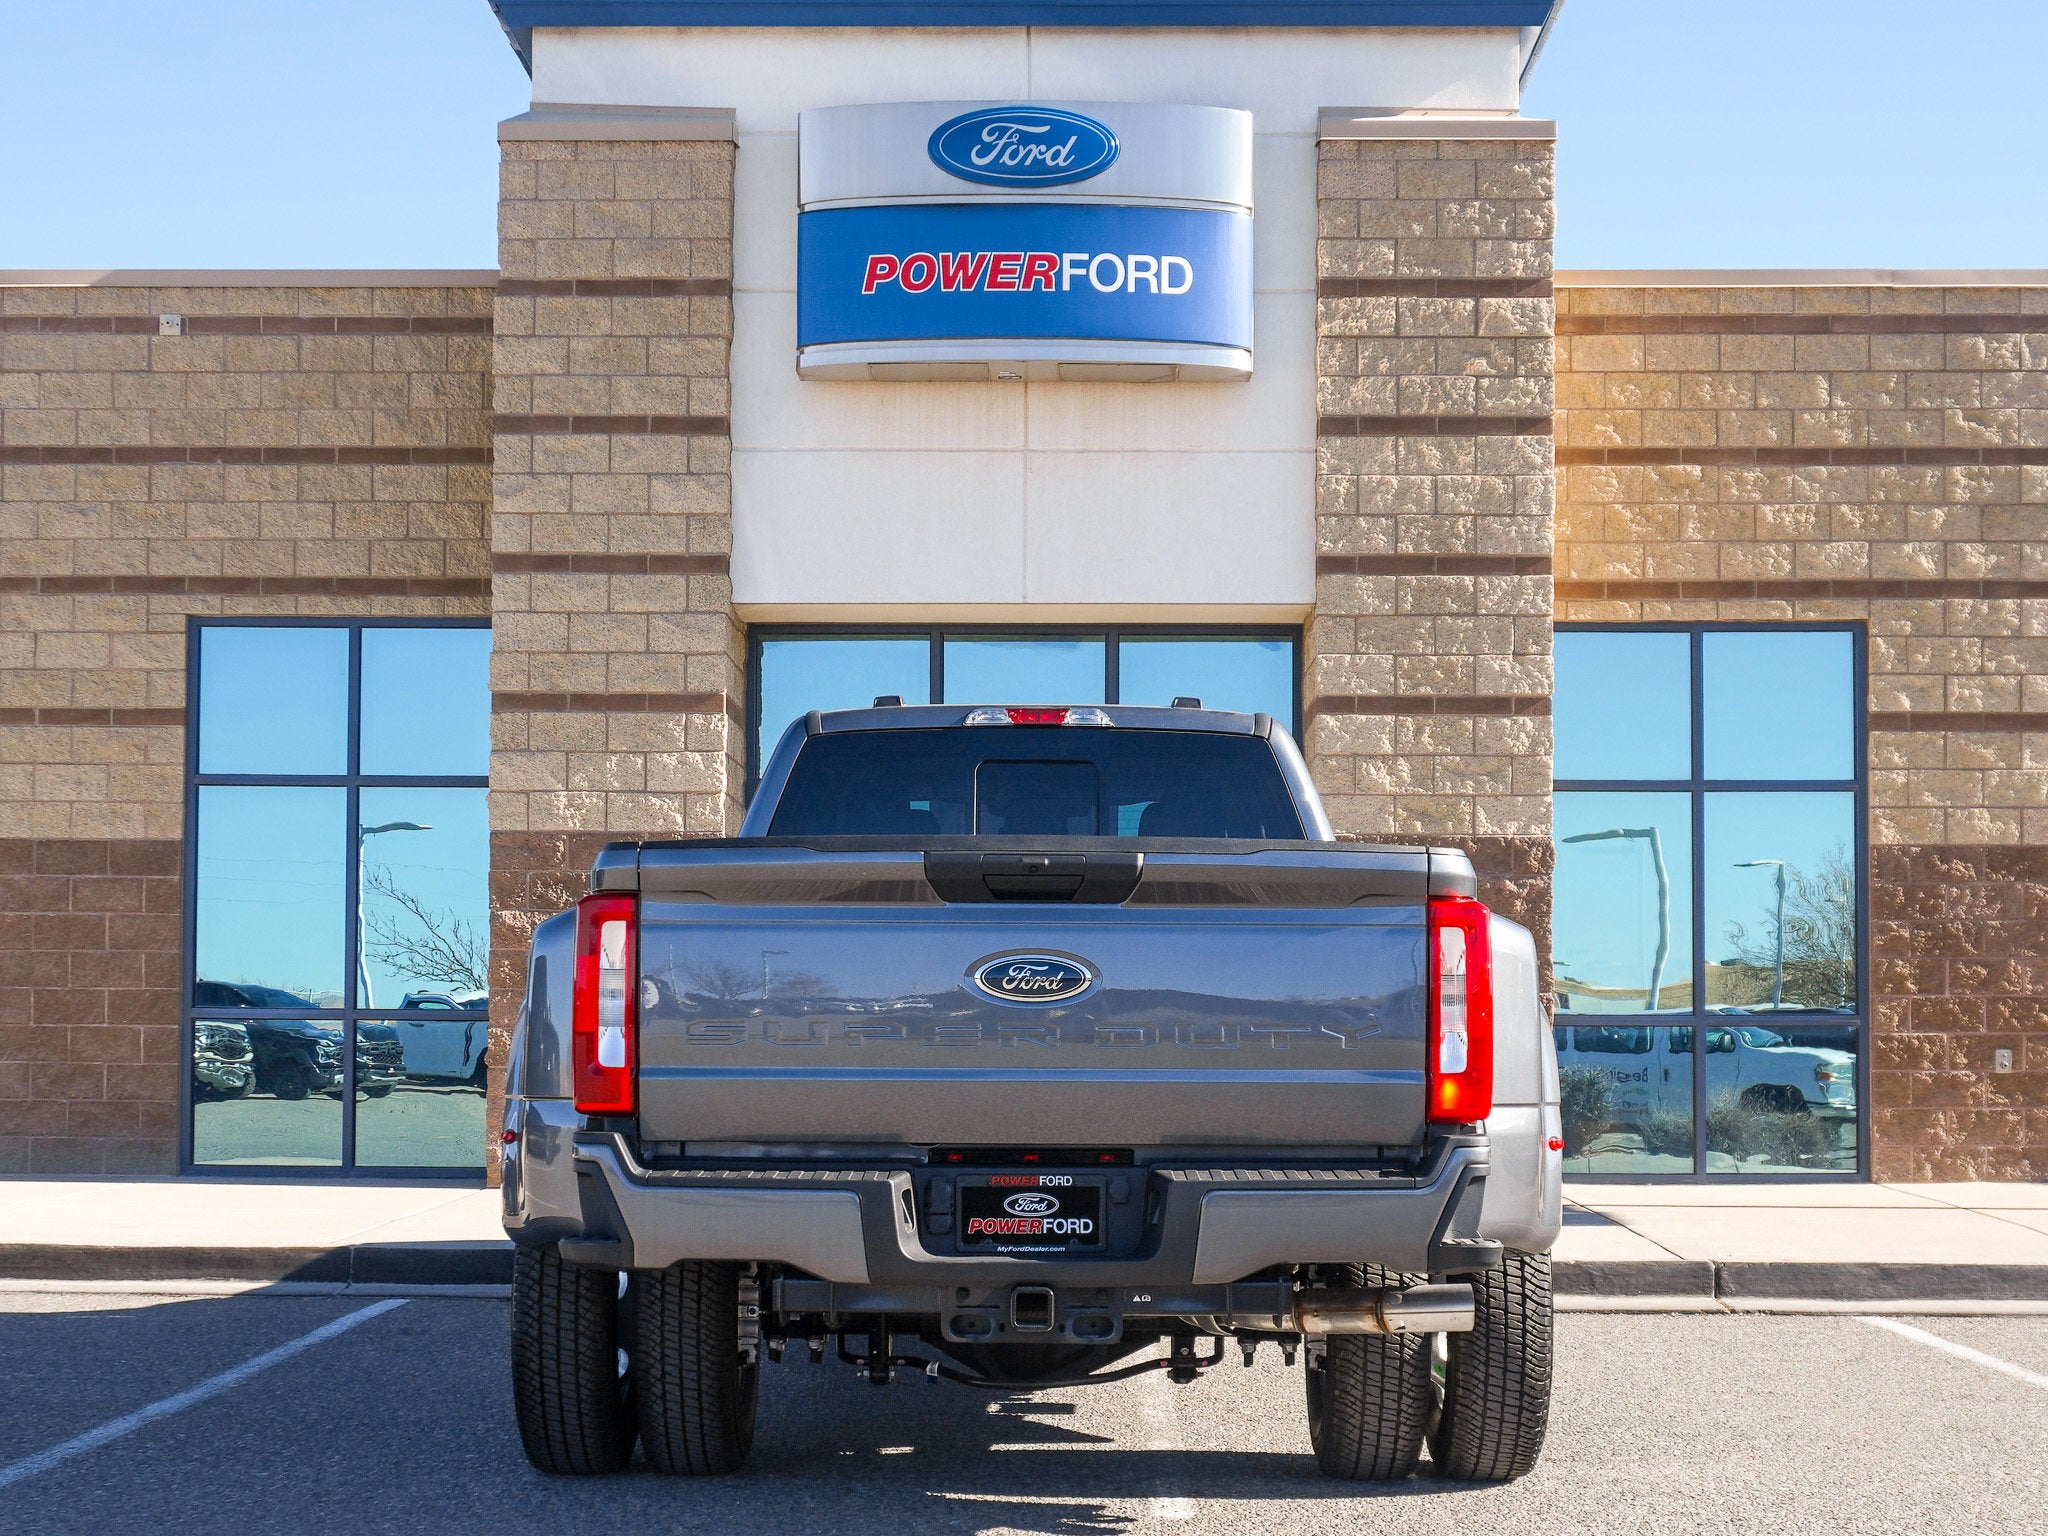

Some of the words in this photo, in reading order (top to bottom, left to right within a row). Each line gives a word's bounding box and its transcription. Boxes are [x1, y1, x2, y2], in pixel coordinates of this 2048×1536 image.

[970, 121, 1078, 167] Ford
[1001, 964, 1065, 990] Ford
[686, 1020, 1060, 1048] SUPER
[1094, 1023, 1382, 1049] DUTY
[1014, 1197, 1048, 1212] Ford
